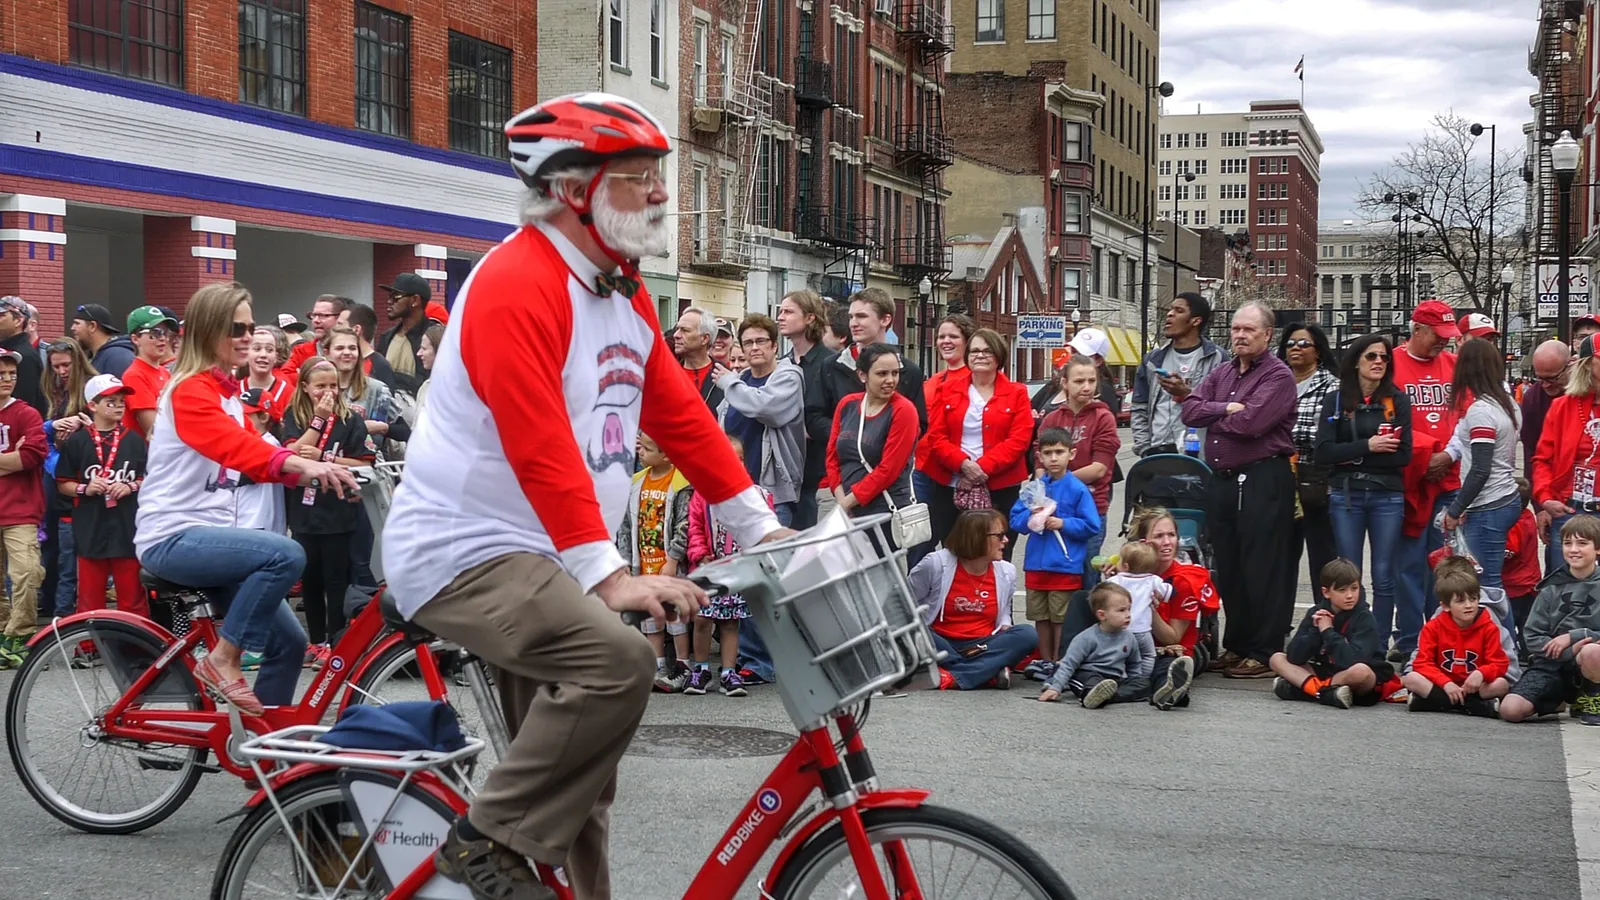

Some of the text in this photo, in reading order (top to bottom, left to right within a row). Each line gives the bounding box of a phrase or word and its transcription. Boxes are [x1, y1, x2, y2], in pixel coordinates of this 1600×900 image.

[1019, 320, 1064, 329] PARKING
[1404, 382, 1453, 406] REDS
[84, 460, 136, 484] Reds
[980, 591, 989, 599] C
[308, 669, 336, 708] REDBIKE
[392, 830, 440, 848] Health
[717, 794, 776, 866] REDBIKE B
